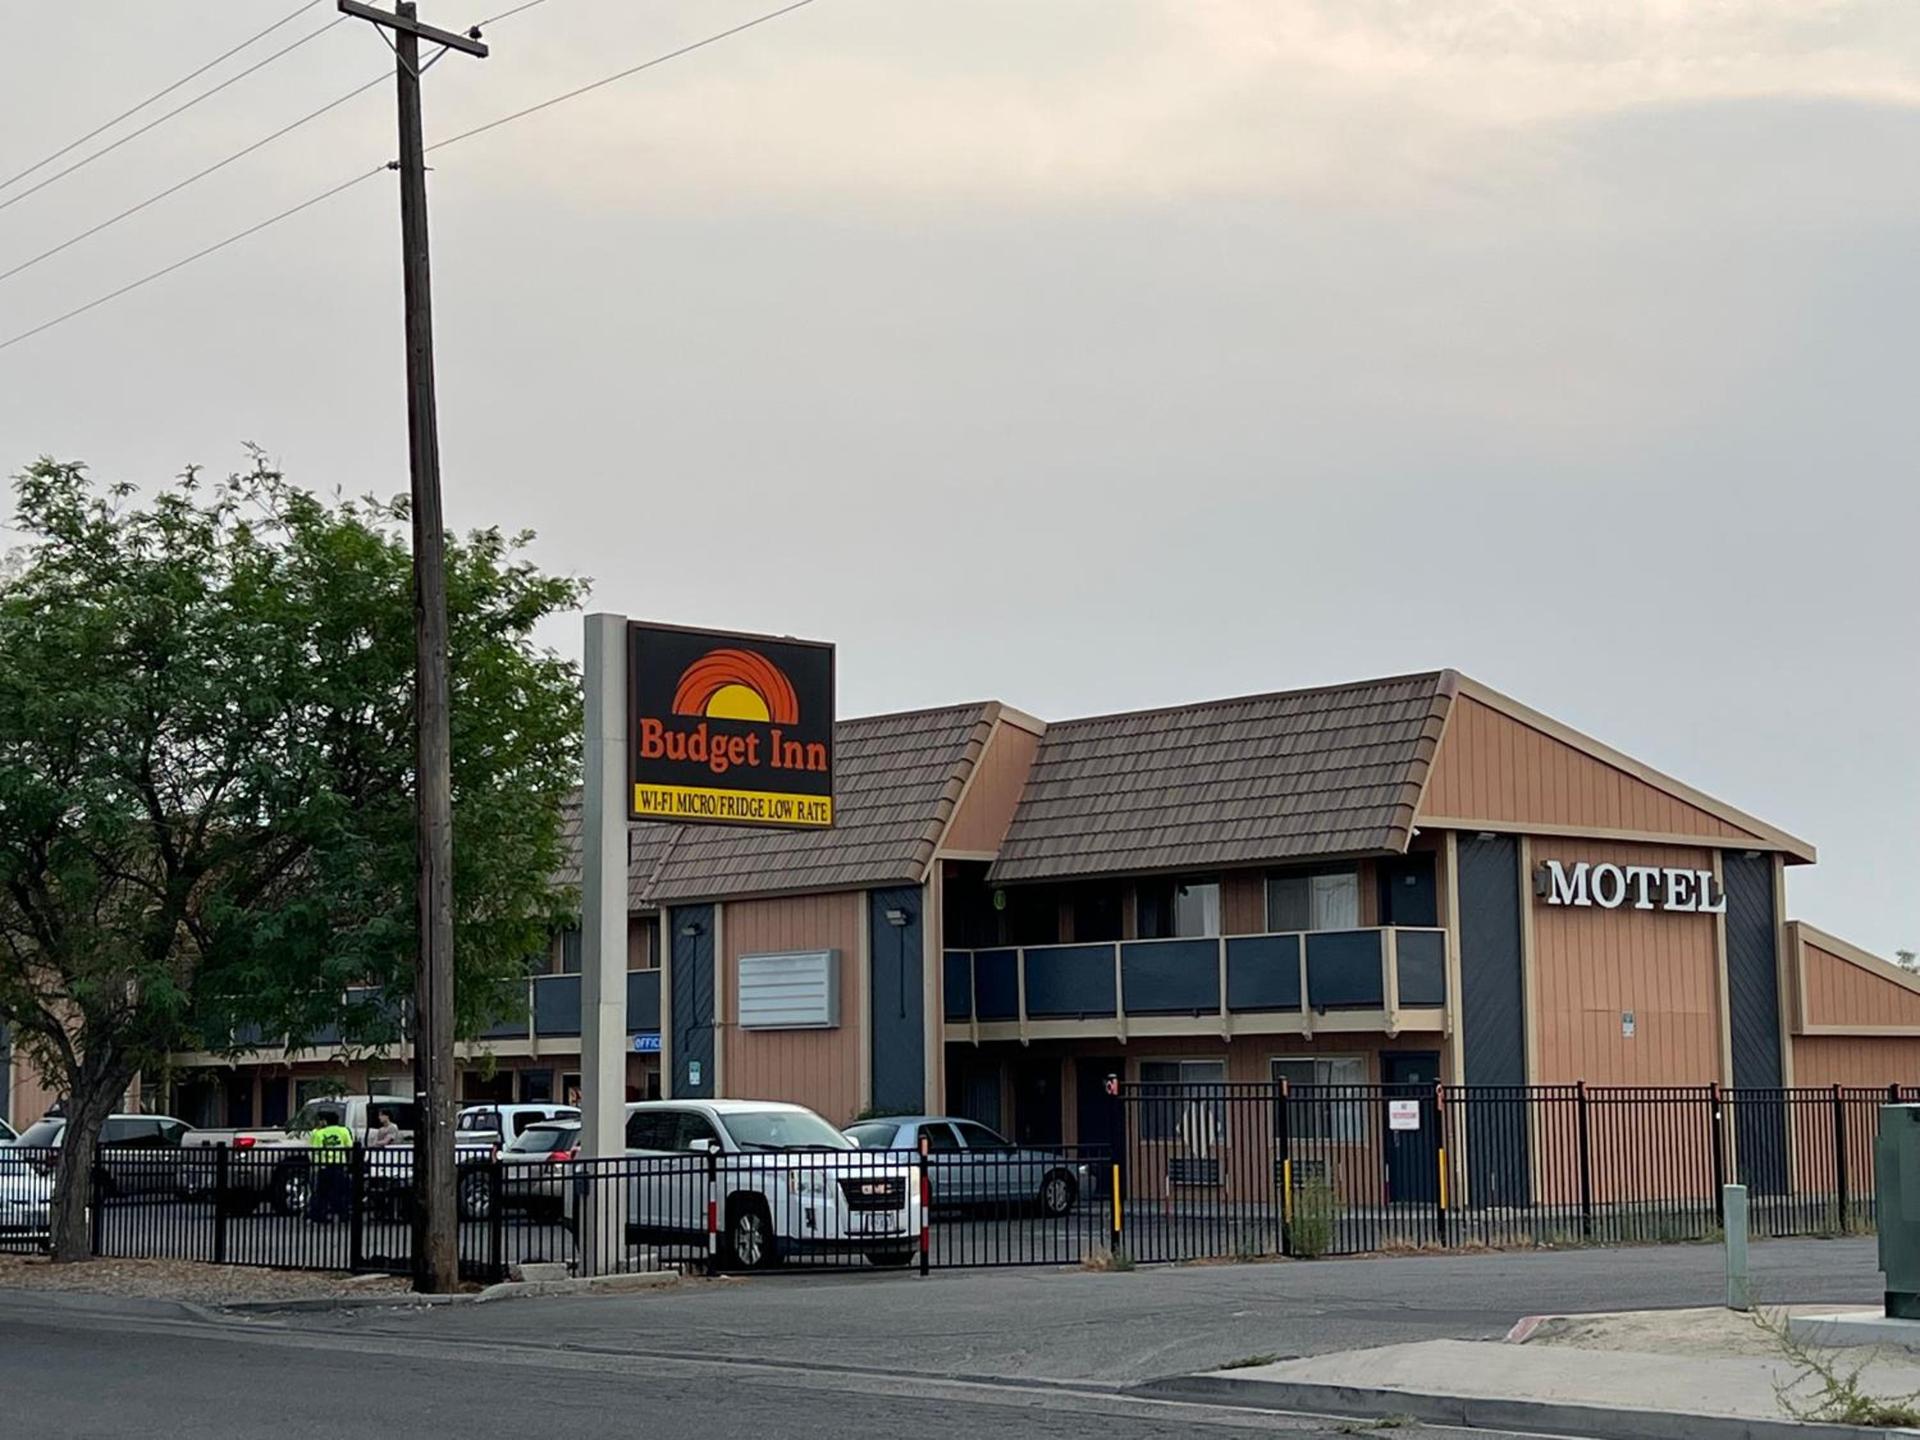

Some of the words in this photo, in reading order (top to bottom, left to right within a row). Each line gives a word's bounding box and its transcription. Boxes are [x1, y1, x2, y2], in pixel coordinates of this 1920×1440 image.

[640, 718, 760, 774] Budget
[770, 729, 828, 771] Inn
[767, 798, 794, 819] LOW
[797, 801, 828, 822] RATE
[1547, 860, 1727, 914] MOTEL
[635, 1037, 661, 1049] OFFIC
